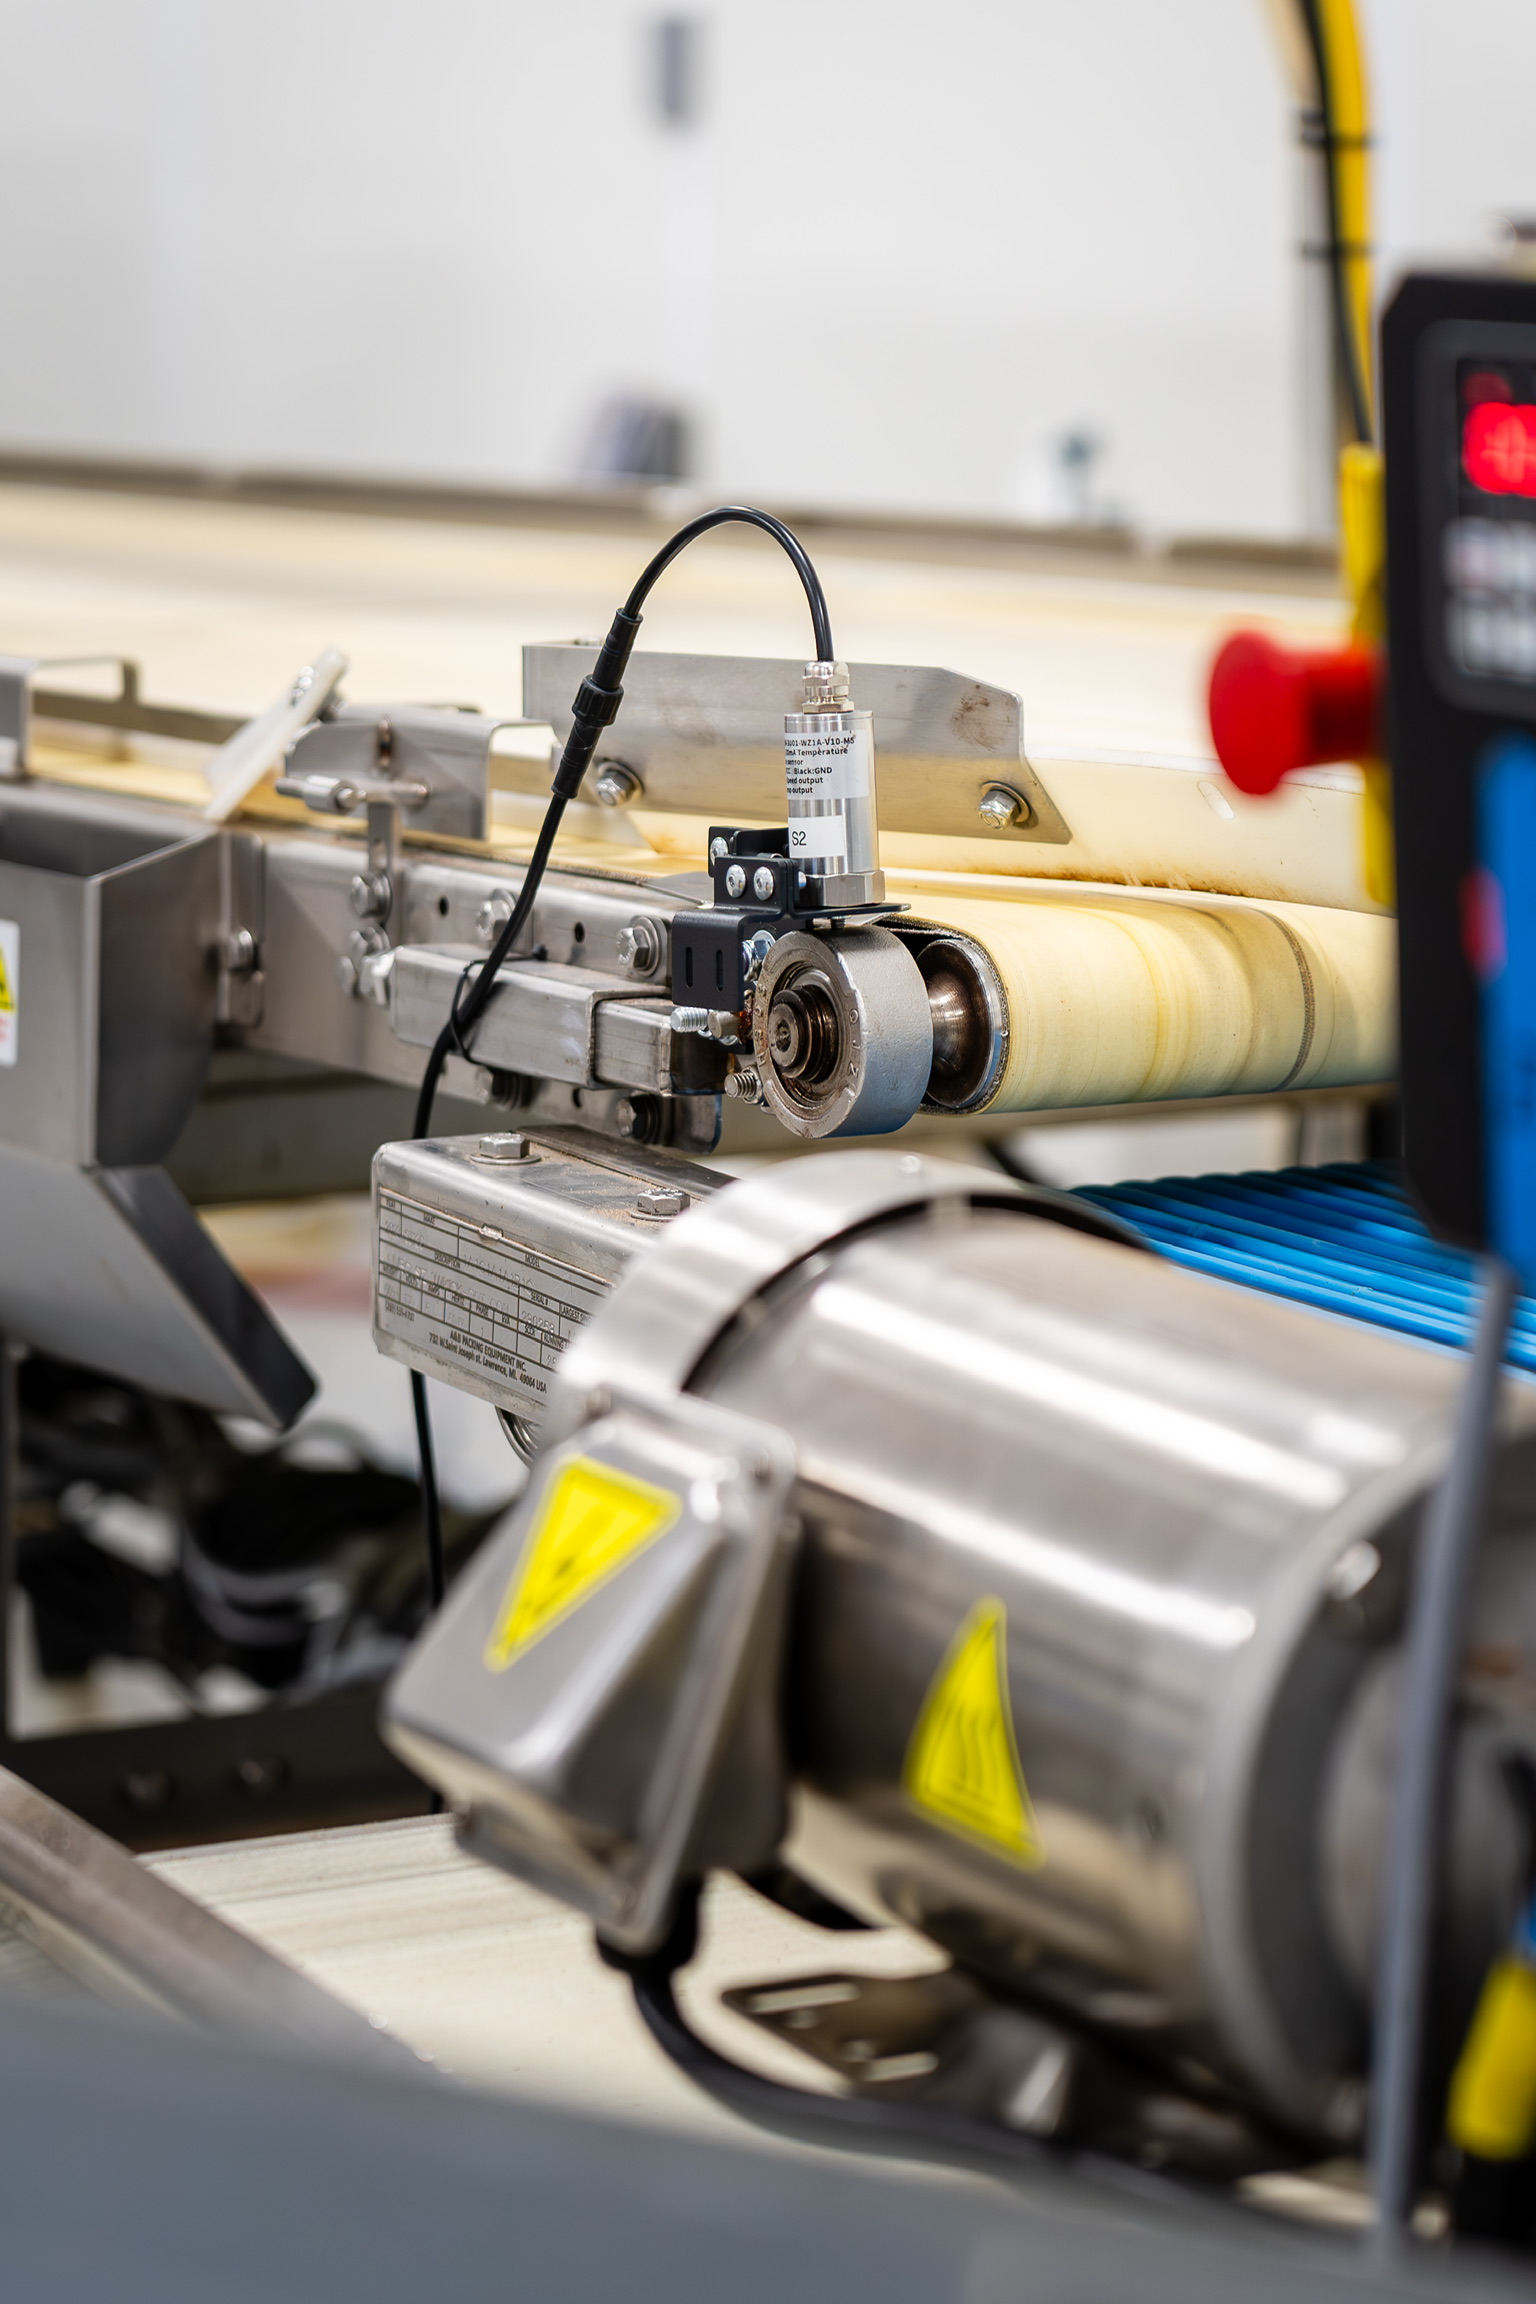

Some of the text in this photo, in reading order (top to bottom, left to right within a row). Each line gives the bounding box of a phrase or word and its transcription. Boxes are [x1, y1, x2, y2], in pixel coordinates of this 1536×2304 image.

[798, 748, 848, 757] Temperature
[794, 767, 832, 775] Black:GND
[799, 777, 823, 785] output
[792, 787, 813, 795] output
[791, 831, 807, 846] S2
[525, 1253, 540, 1267] MODEL
[531, 1290, 544, 1304] SERIAL
[561, 1304, 581, 1320] LARGEST
[462, 1334, 484, 1354] PACKING
[484, 1345, 515, 1366] EQUIPMENT
[516, 1358, 527, 1372] INC.
[458, 1345, 475, 1362] Joseph
[536, 1381, 547, 1394] USA
